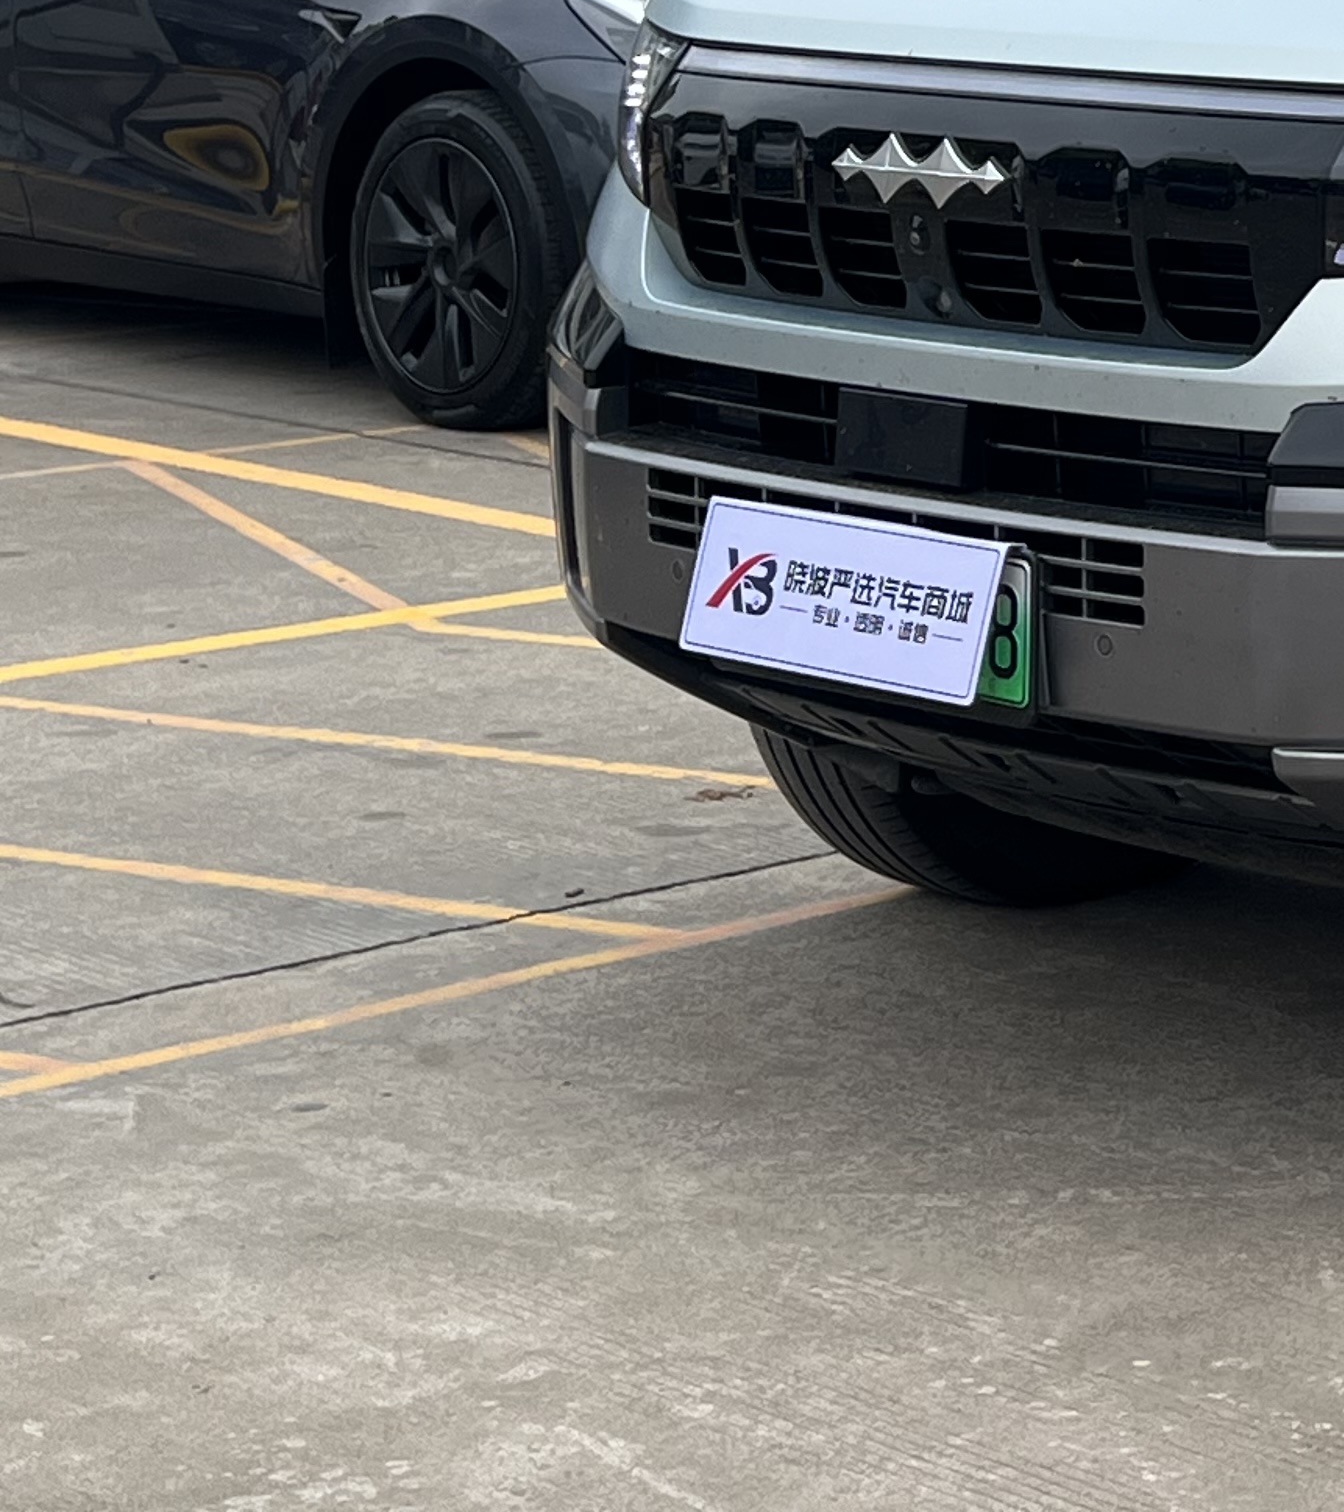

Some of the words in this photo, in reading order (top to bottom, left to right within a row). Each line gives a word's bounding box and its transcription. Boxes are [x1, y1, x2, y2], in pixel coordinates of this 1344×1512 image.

[783, 560, 974, 624] 晓波严选汽车商城
[988, 586, 1019, 679] 8
